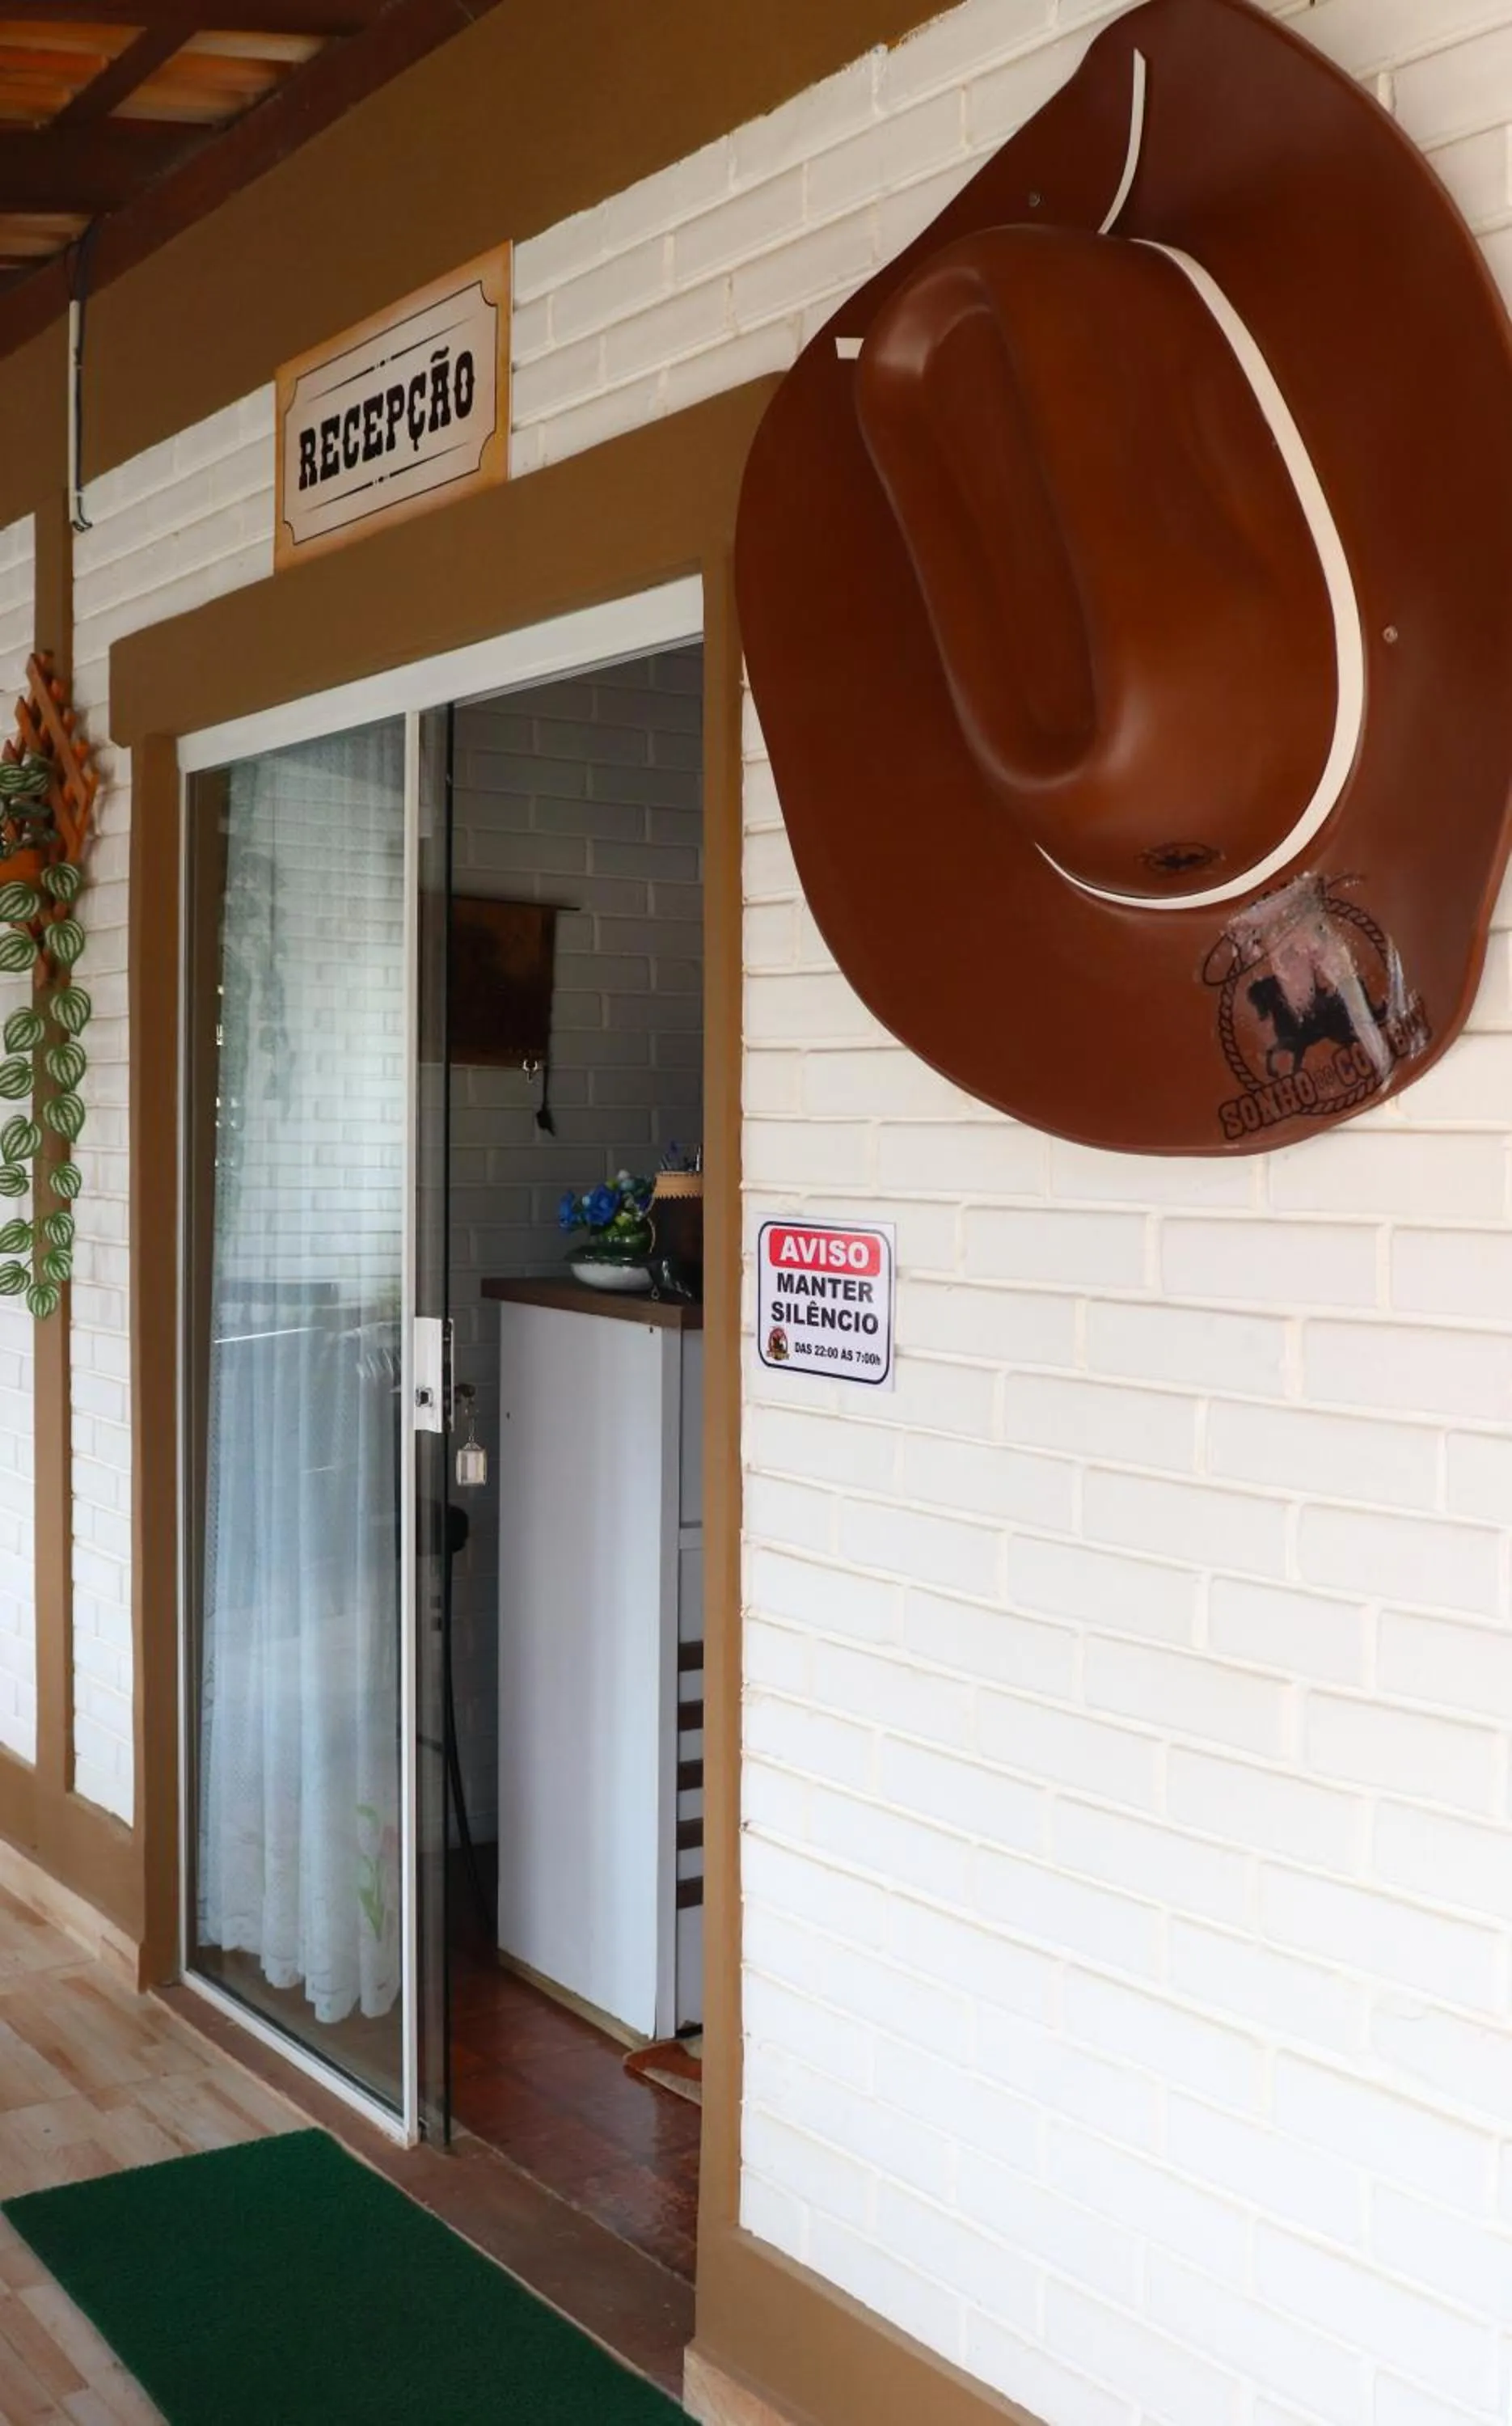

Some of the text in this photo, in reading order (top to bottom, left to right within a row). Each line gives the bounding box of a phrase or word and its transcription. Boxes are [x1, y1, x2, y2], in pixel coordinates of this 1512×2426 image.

[298, 345, 475, 491] RECEPÇÃO
[1218, 1074, 1317, 1140] SONHO
[779, 1236, 869, 1269] AVISO
[776, 1272, 873, 1303] MANTER
[771, 1300, 879, 1335] SILÊNCIO
[794, 1342, 812, 1355] DAS
[814, 1345, 838, 1359] 22:00
